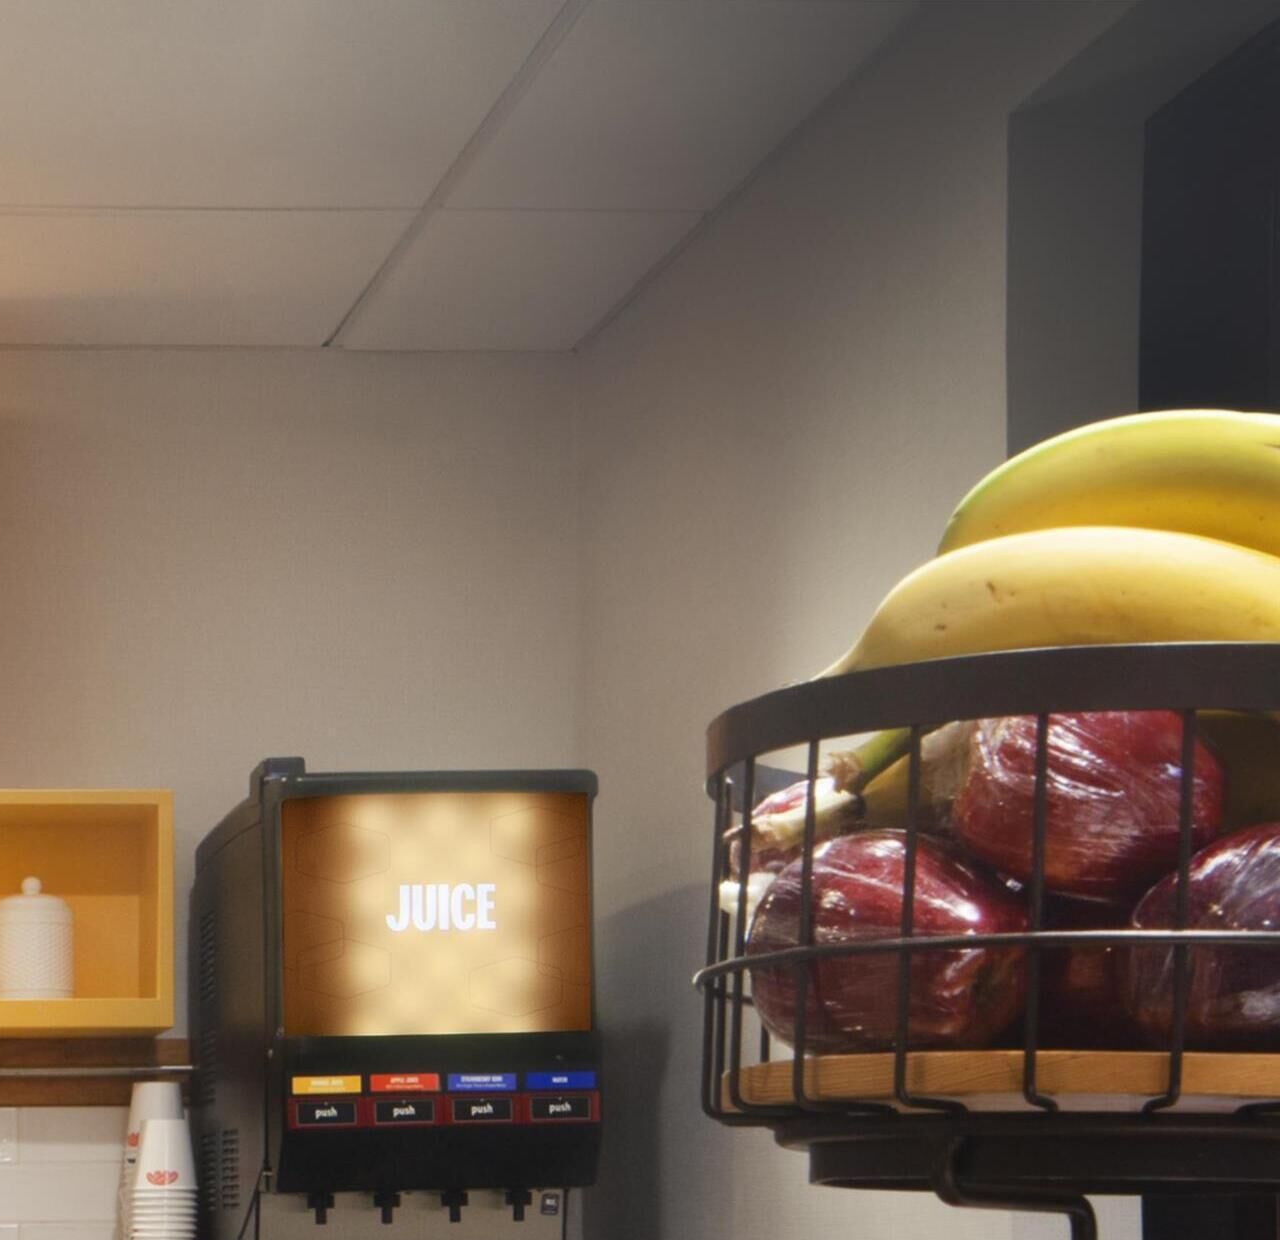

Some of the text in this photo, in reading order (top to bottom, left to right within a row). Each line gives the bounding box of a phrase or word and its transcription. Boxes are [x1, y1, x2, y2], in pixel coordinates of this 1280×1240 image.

[385, 883, 497, 933] JUICE
[315, 1106, 338, 1120] push
[393, 1105, 416, 1118] push
[471, 1103, 494, 1116] push
[549, 1102, 572, 1115] push
